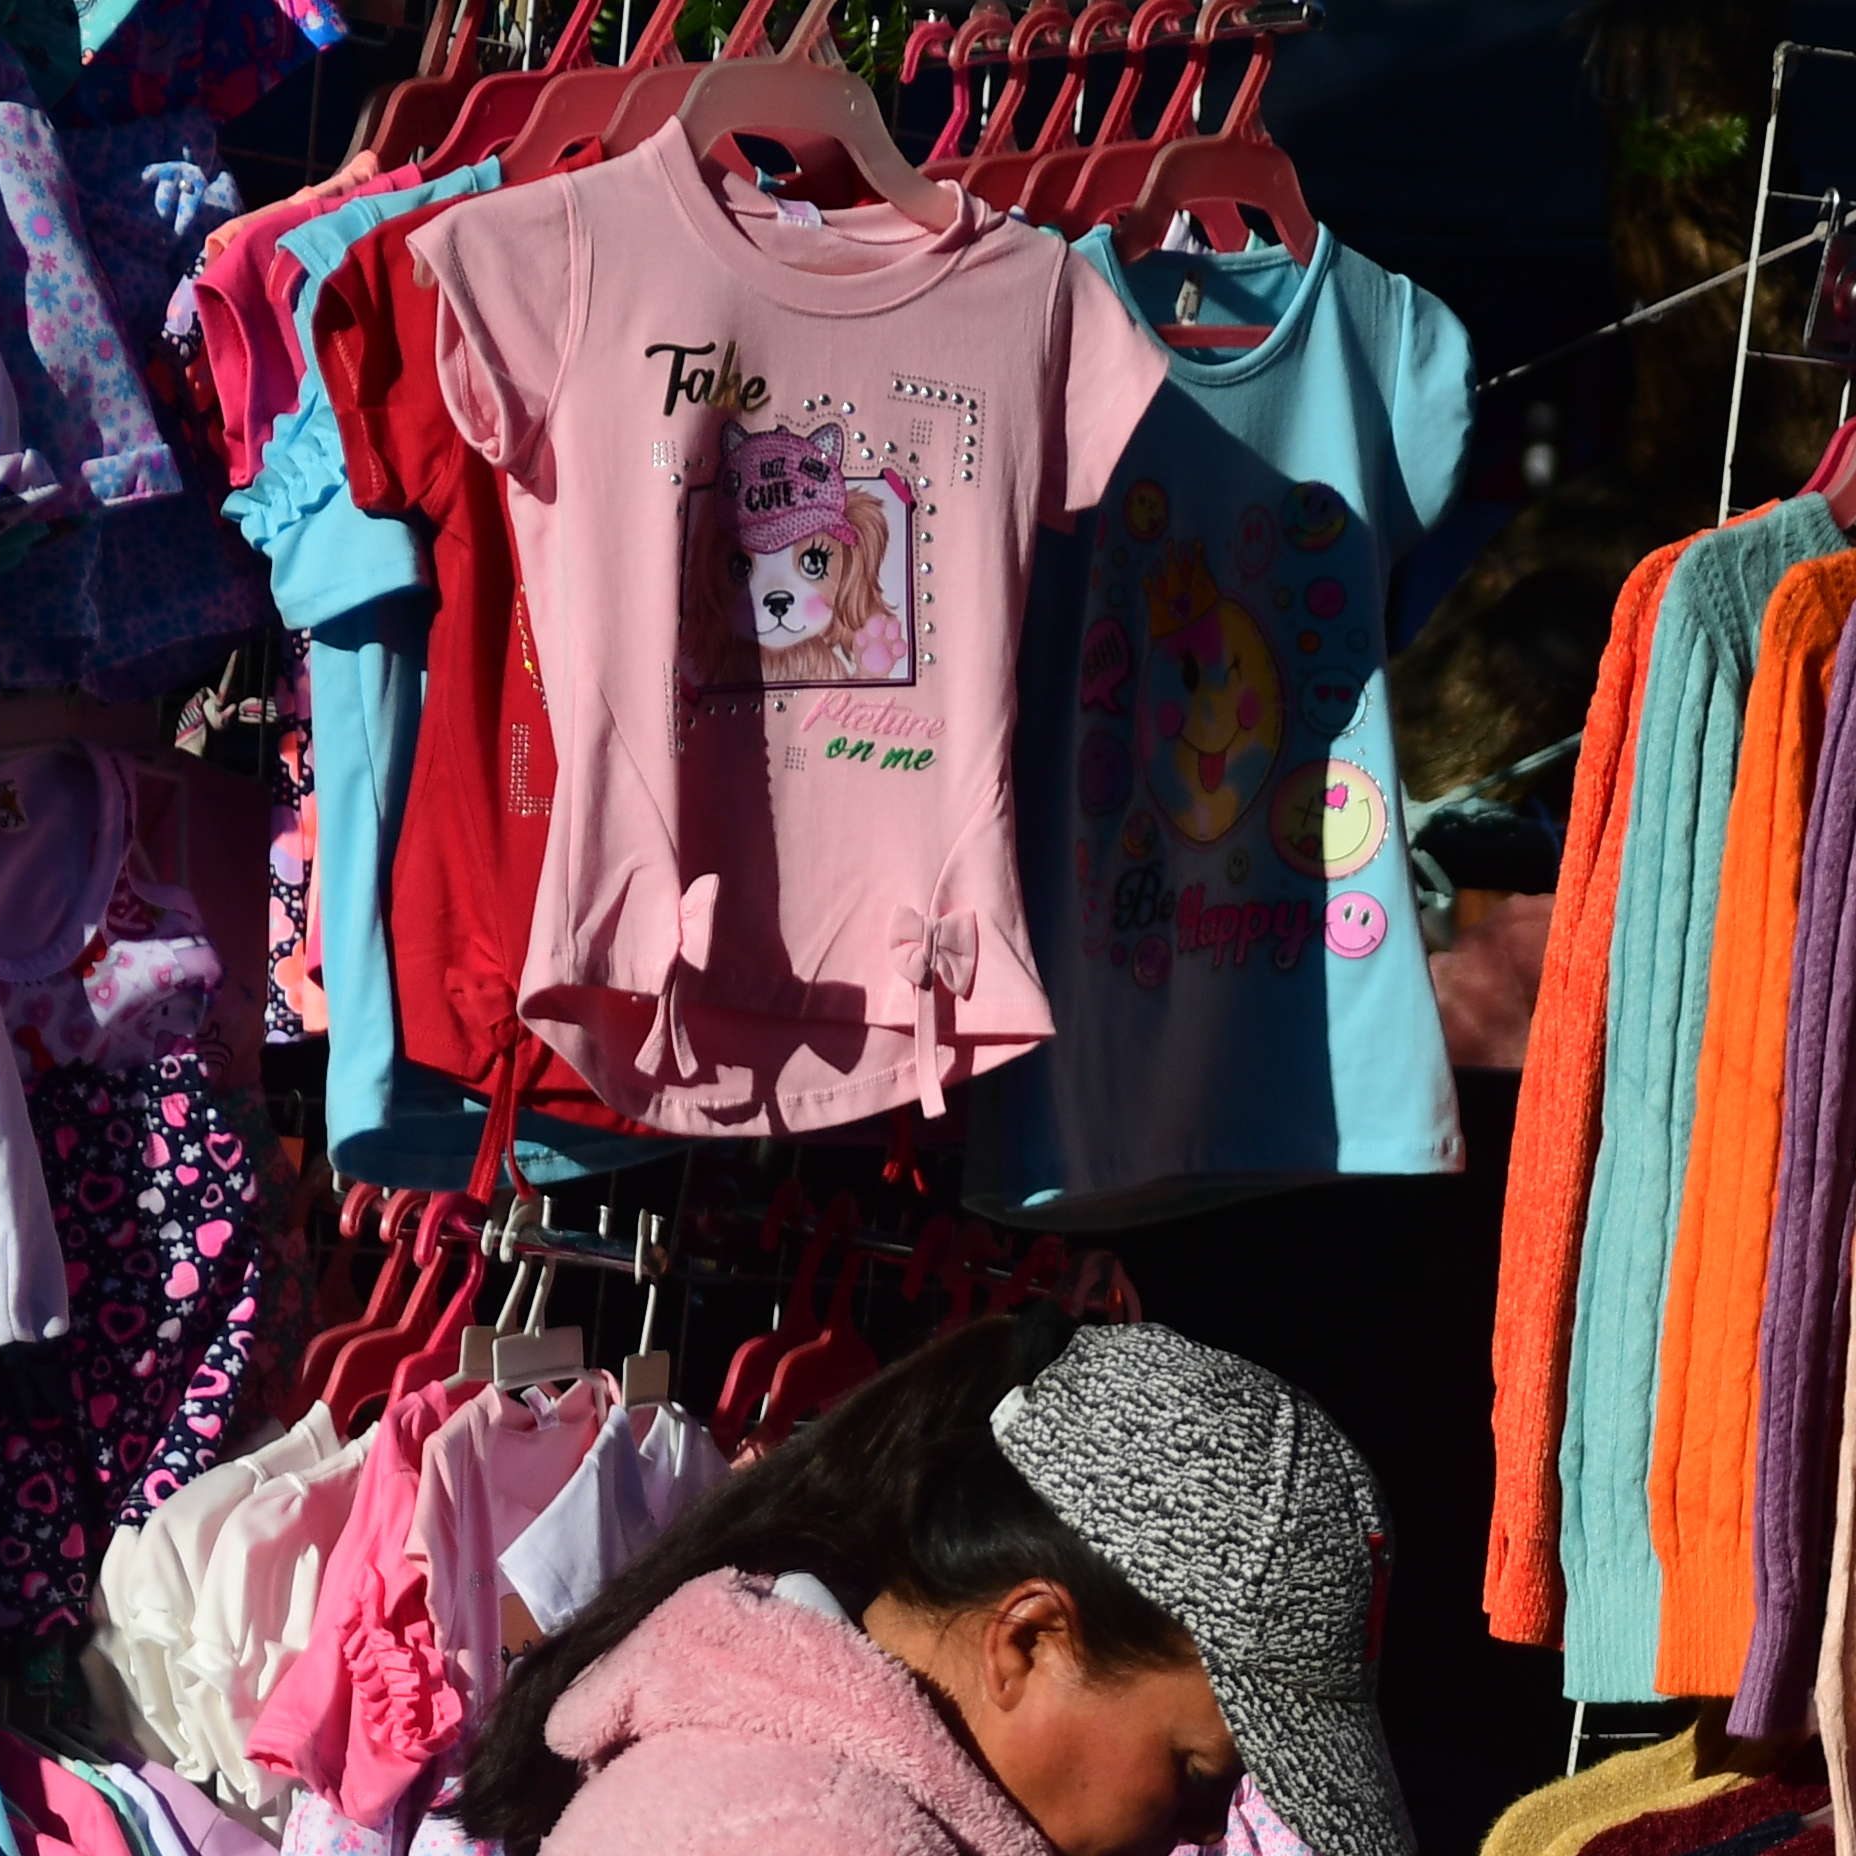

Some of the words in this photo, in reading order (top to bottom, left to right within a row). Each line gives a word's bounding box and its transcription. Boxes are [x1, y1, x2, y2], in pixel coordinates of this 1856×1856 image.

[645, 341, 771, 416] Take
[745, 480, 796, 511] CUTE
[825, 736, 875, 762] on
[880, 748, 936, 770] me
[1176, 883, 1315, 970] Happy
